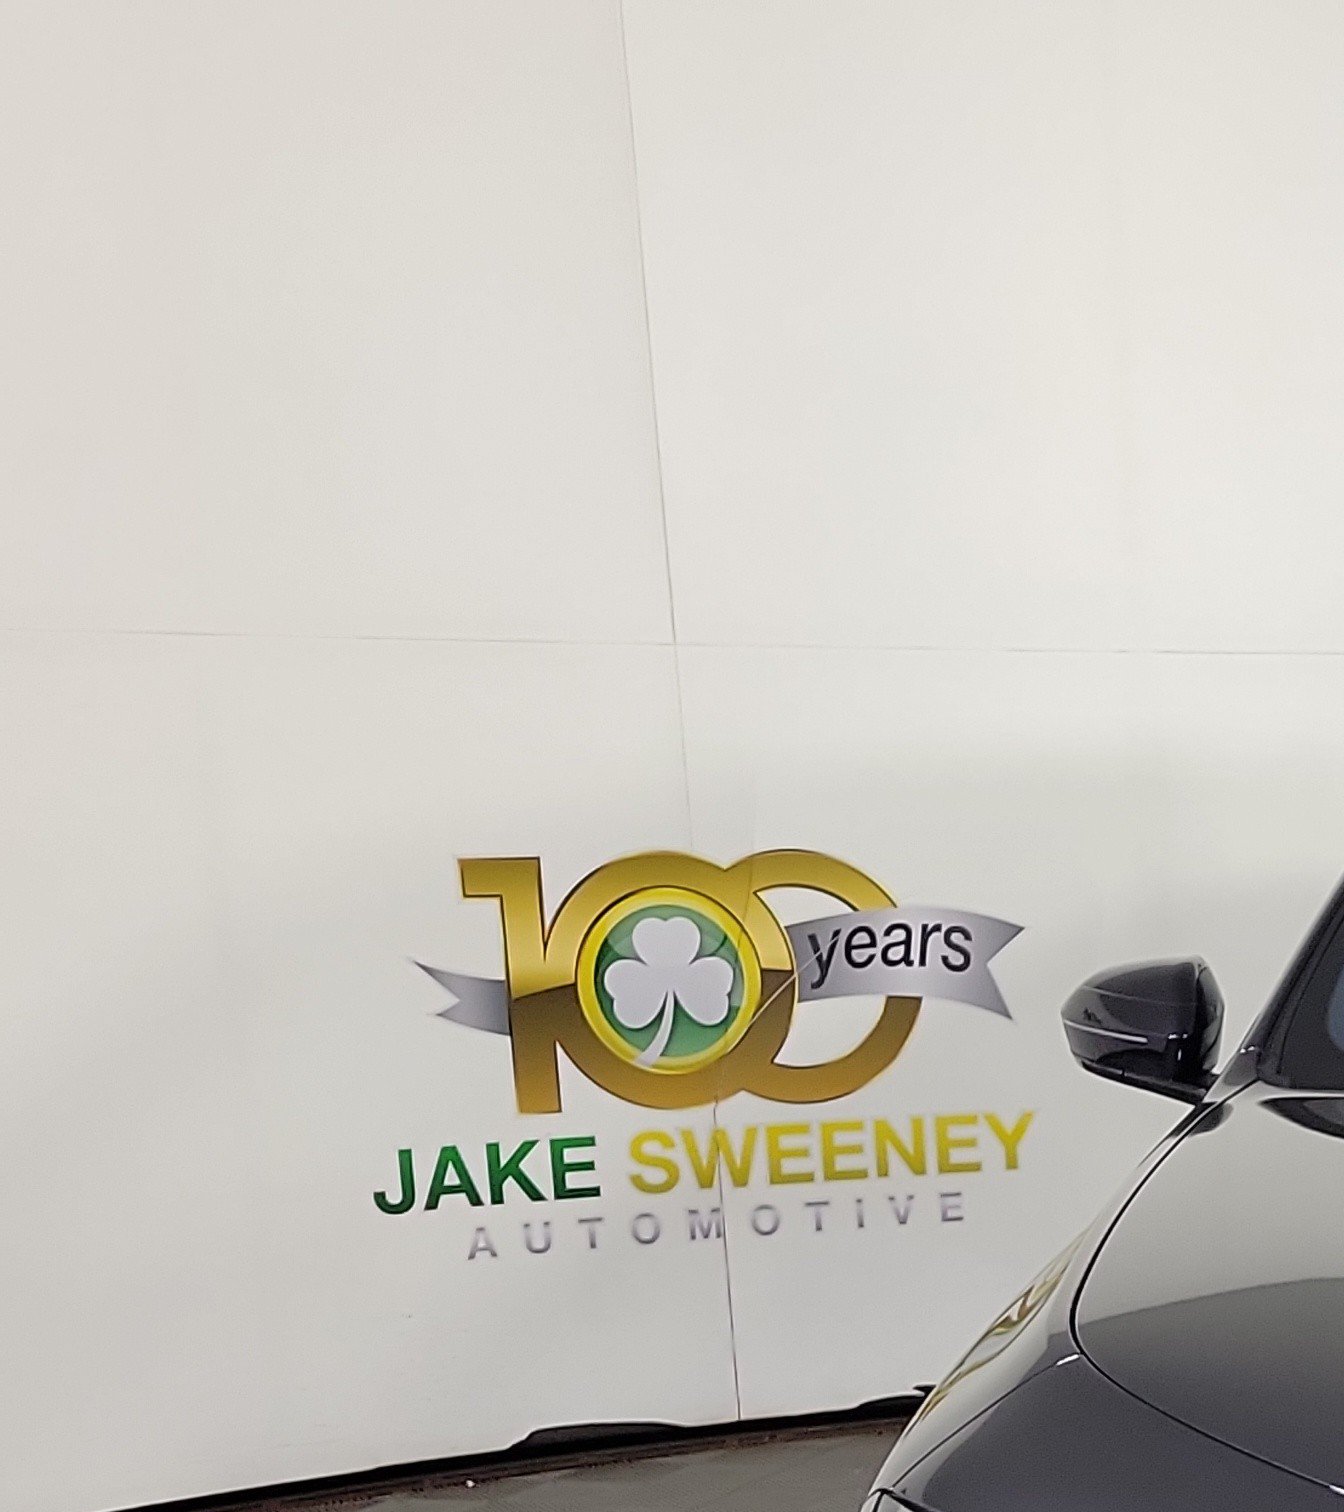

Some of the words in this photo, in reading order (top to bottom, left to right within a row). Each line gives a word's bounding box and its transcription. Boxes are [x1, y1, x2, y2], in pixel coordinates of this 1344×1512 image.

[456, 849, 922, 1114] 100
[807, 920, 973, 990] years
[373, 1135, 602, 1215] JAKE
[628, 1111, 1036, 1195] SWEENEY
[466, 1191, 966, 1261] AUTOMOTIVE
